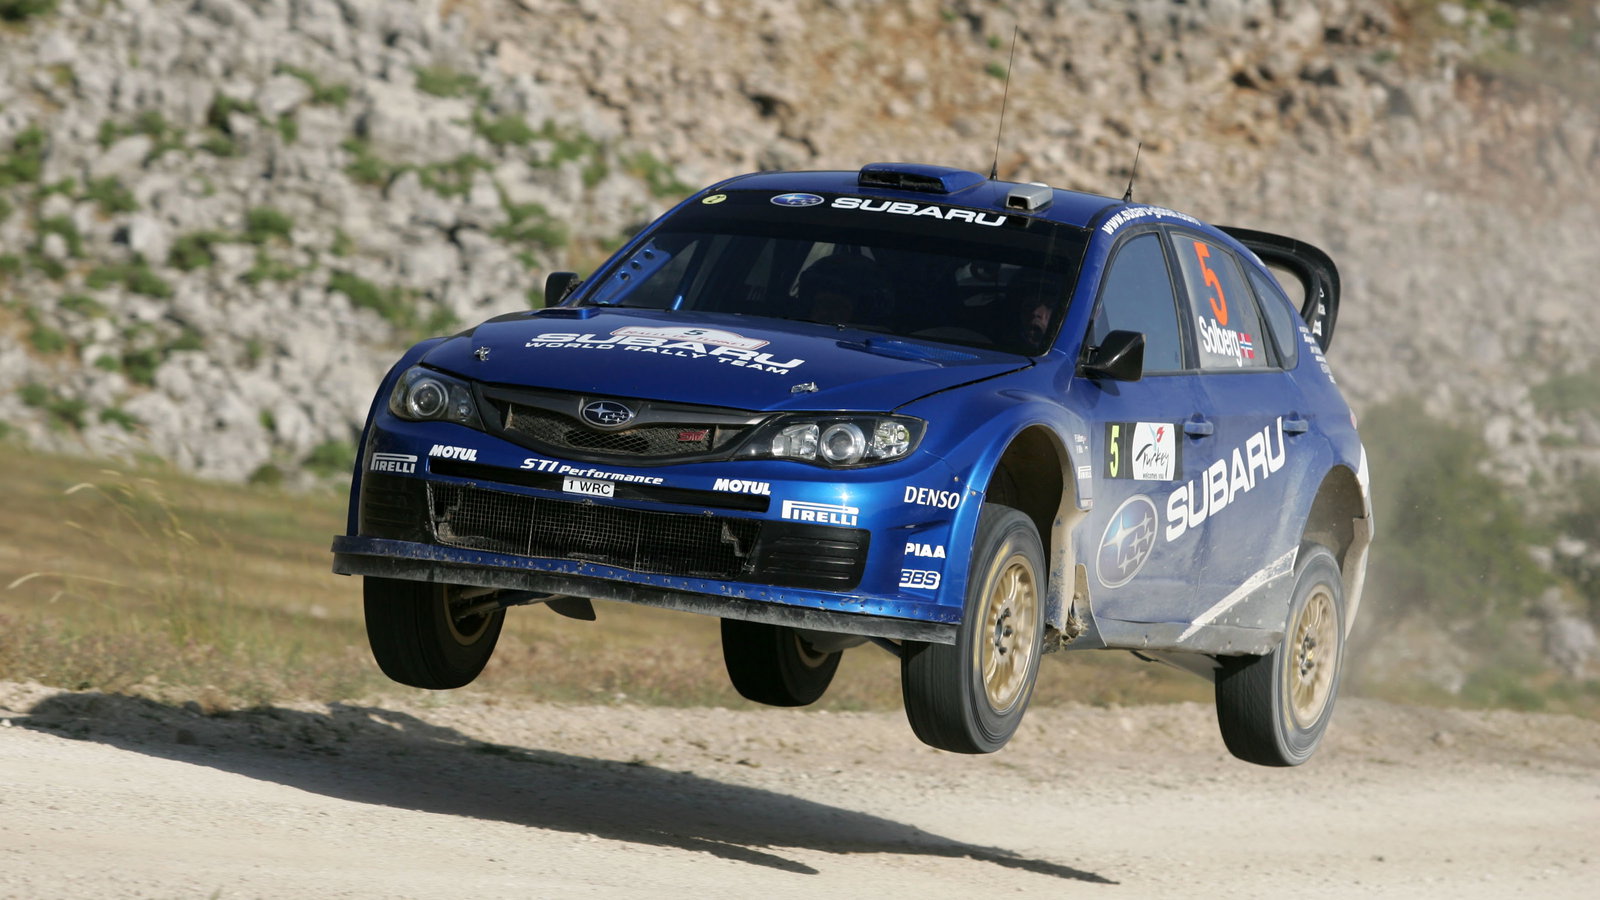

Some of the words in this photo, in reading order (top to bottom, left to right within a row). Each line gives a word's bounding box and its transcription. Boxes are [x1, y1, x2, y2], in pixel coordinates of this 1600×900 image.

[831, 197, 1007, 227] SUBARU
[1193, 241, 1228, 326] 5
[531, 333, 805, 368] SUBARU
[1198, 315, 1243, 367] Solberg
[525, 342, 615, 350] WORLD
[624, 345, 707, 358] RALLY
[718, 356, 789, 375] TEAM
[370, 452, 418, 474] PIRELLI
[428, 444, 478, 462] MOTUL
[1109, 425, 1120, 478] 5
[520, 457, 560, 473] STI
[558, 464, 664, 485] Performance
[1165, 415, 1286, 543] SUBARU
[568, 480, 574, 490] 1
[579, 481, 610, 494] WRC
[712, 478, 771, 495] MOTUL
[903, 485, 960, 510] DENSO
[781, 499, 860, 526] PIRELLI
[904, 542, 946, 559] PIAA
[898, 568, 941, 590] BBS
